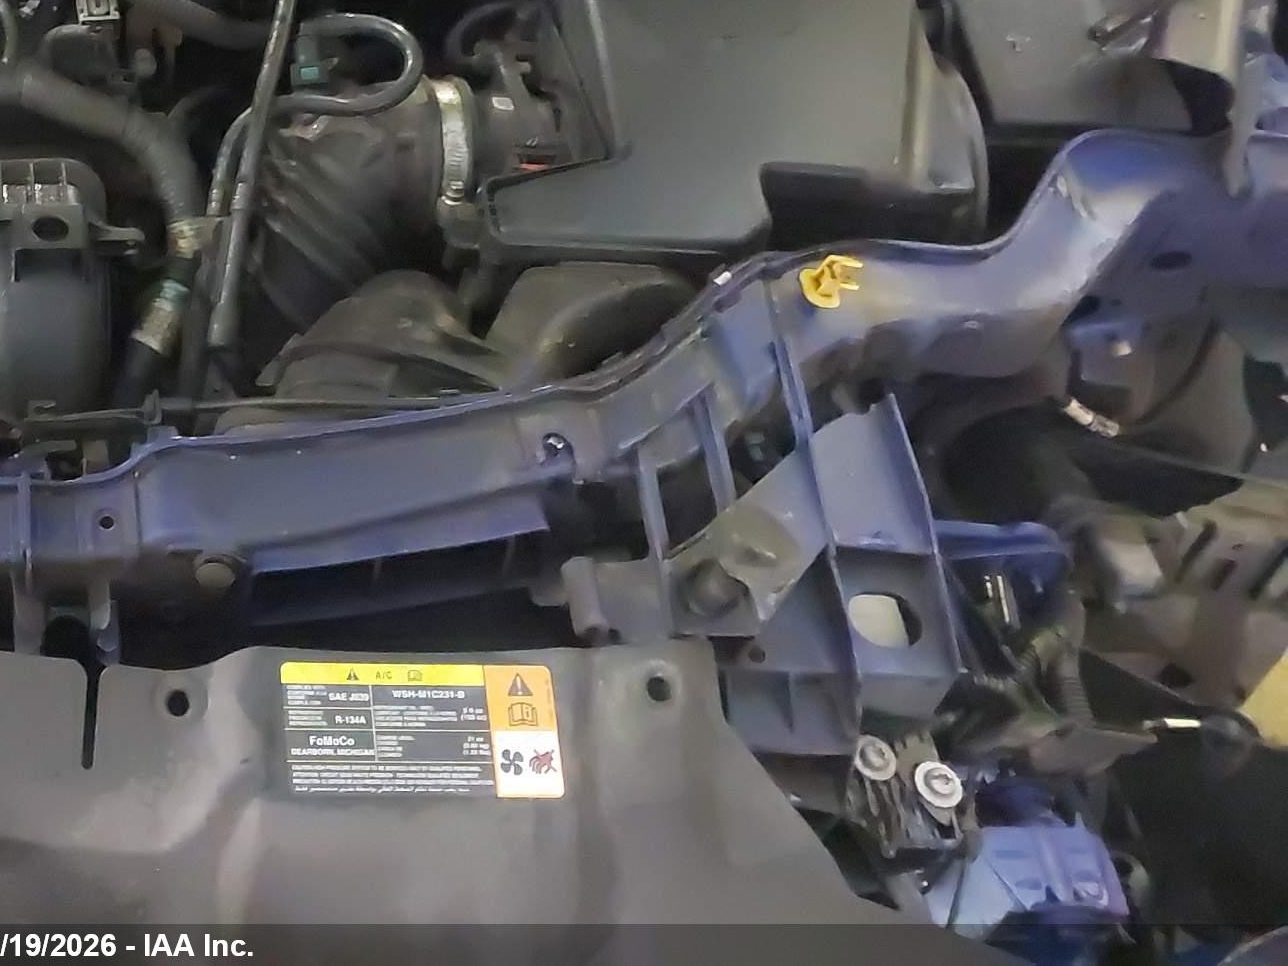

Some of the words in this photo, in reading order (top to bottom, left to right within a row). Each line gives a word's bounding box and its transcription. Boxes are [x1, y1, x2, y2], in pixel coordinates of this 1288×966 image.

[375, 670, 393, 681] A/C
[328, 692, 348, 701] SAE
[334, 715, 367, 724] R-134A
[308, 735, 355, 746] FoMoCo
